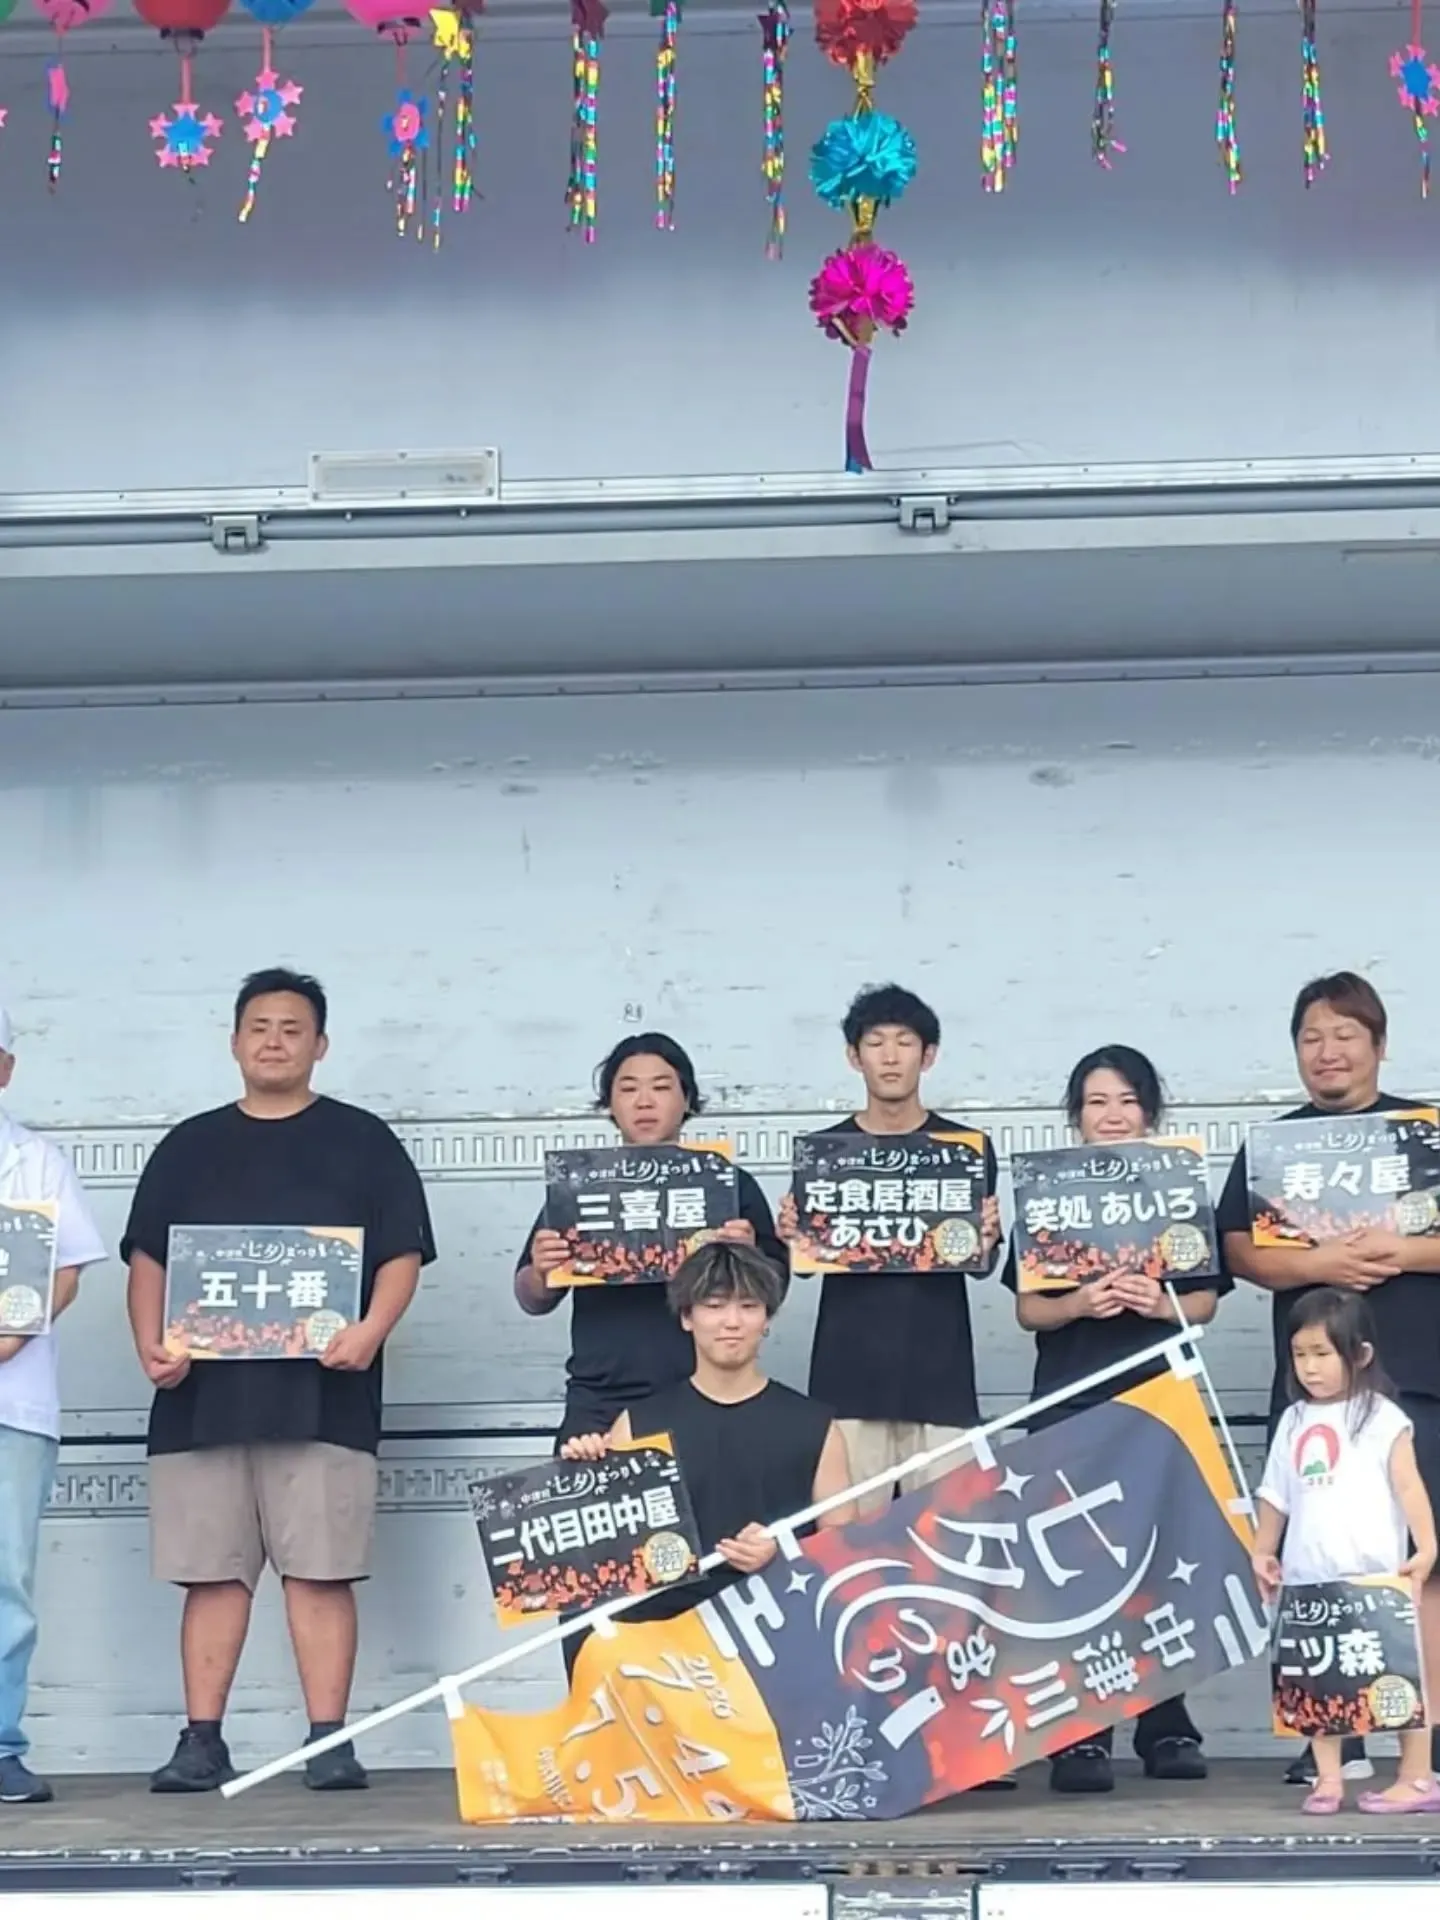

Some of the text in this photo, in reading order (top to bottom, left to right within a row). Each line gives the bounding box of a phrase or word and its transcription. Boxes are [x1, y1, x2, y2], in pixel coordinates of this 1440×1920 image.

[804, 1178, 972, 1213] 定食居酒屋
[1281, 1153, 1412, 1201] 寿々屋
[575, 1188, 708, 1233] 三喜屋
[830, 1215, 929, 1248] あさひ
[1024, 1187, 1198, 1233] 笑処 あいろ
[197, 1268, 329, 1309] 五十番
[489, 1485, 680, 1566] 二代目田中屋
[1008, 1601, 1196, 1730] 中津川
